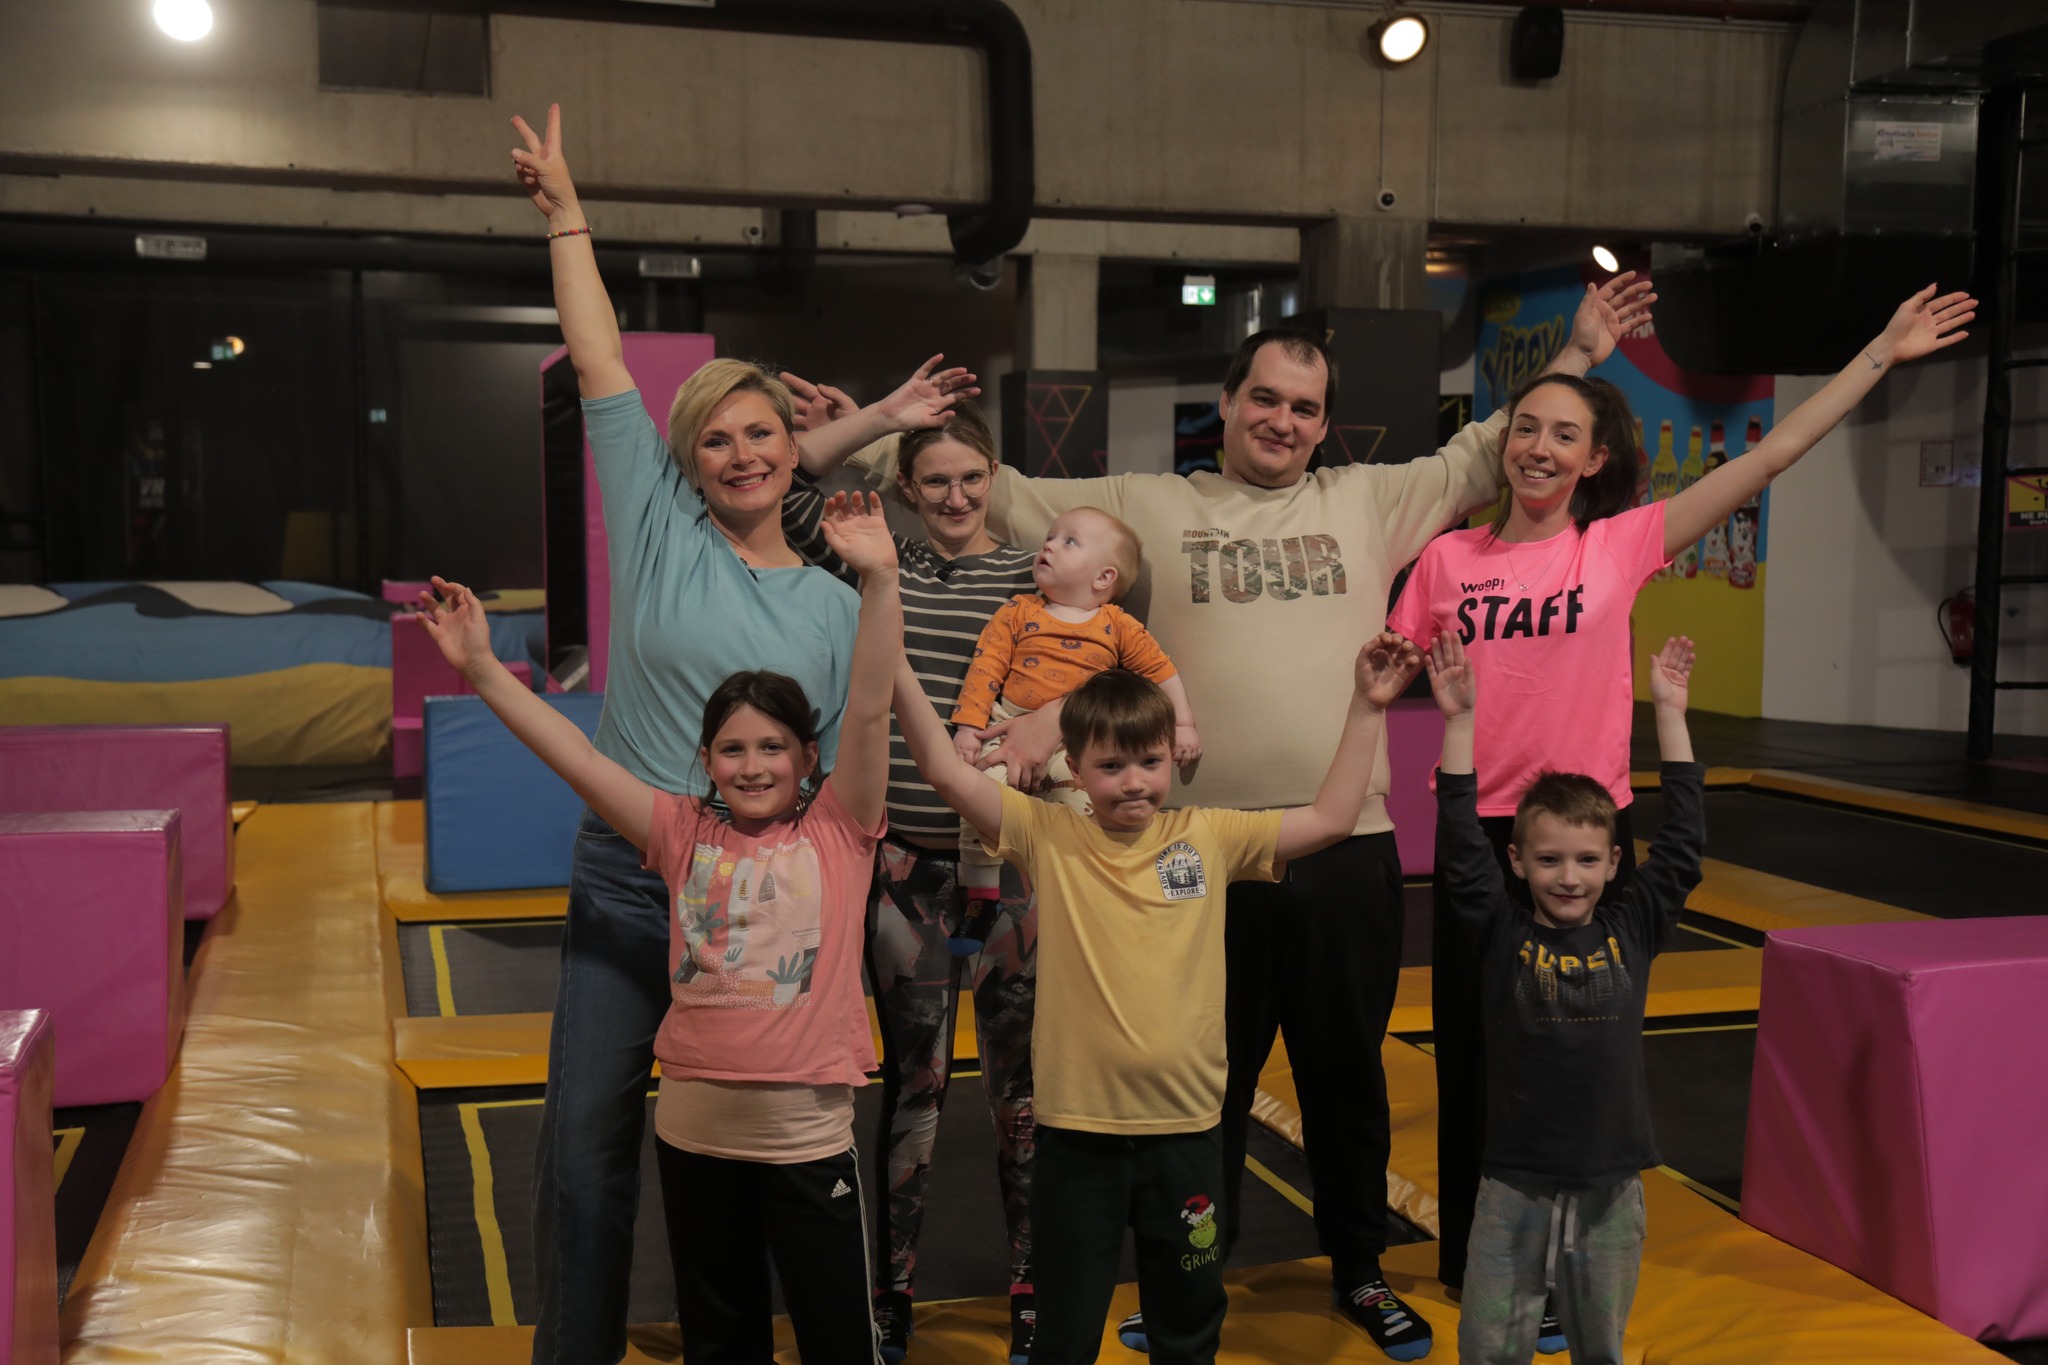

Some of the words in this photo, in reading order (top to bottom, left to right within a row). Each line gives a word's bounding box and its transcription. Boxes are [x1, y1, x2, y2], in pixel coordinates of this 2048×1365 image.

[1181, 533, 1347, 604] TOUR
[1457, 584, 1584, 646] STAFF
[1183, 844, 1198, 857] OUT
[1195, 860, 1205, 885] THERE
[1170, 887, 1200, 896] EXPLORE
[1180, 1245, 1220, 1271] GRINC
